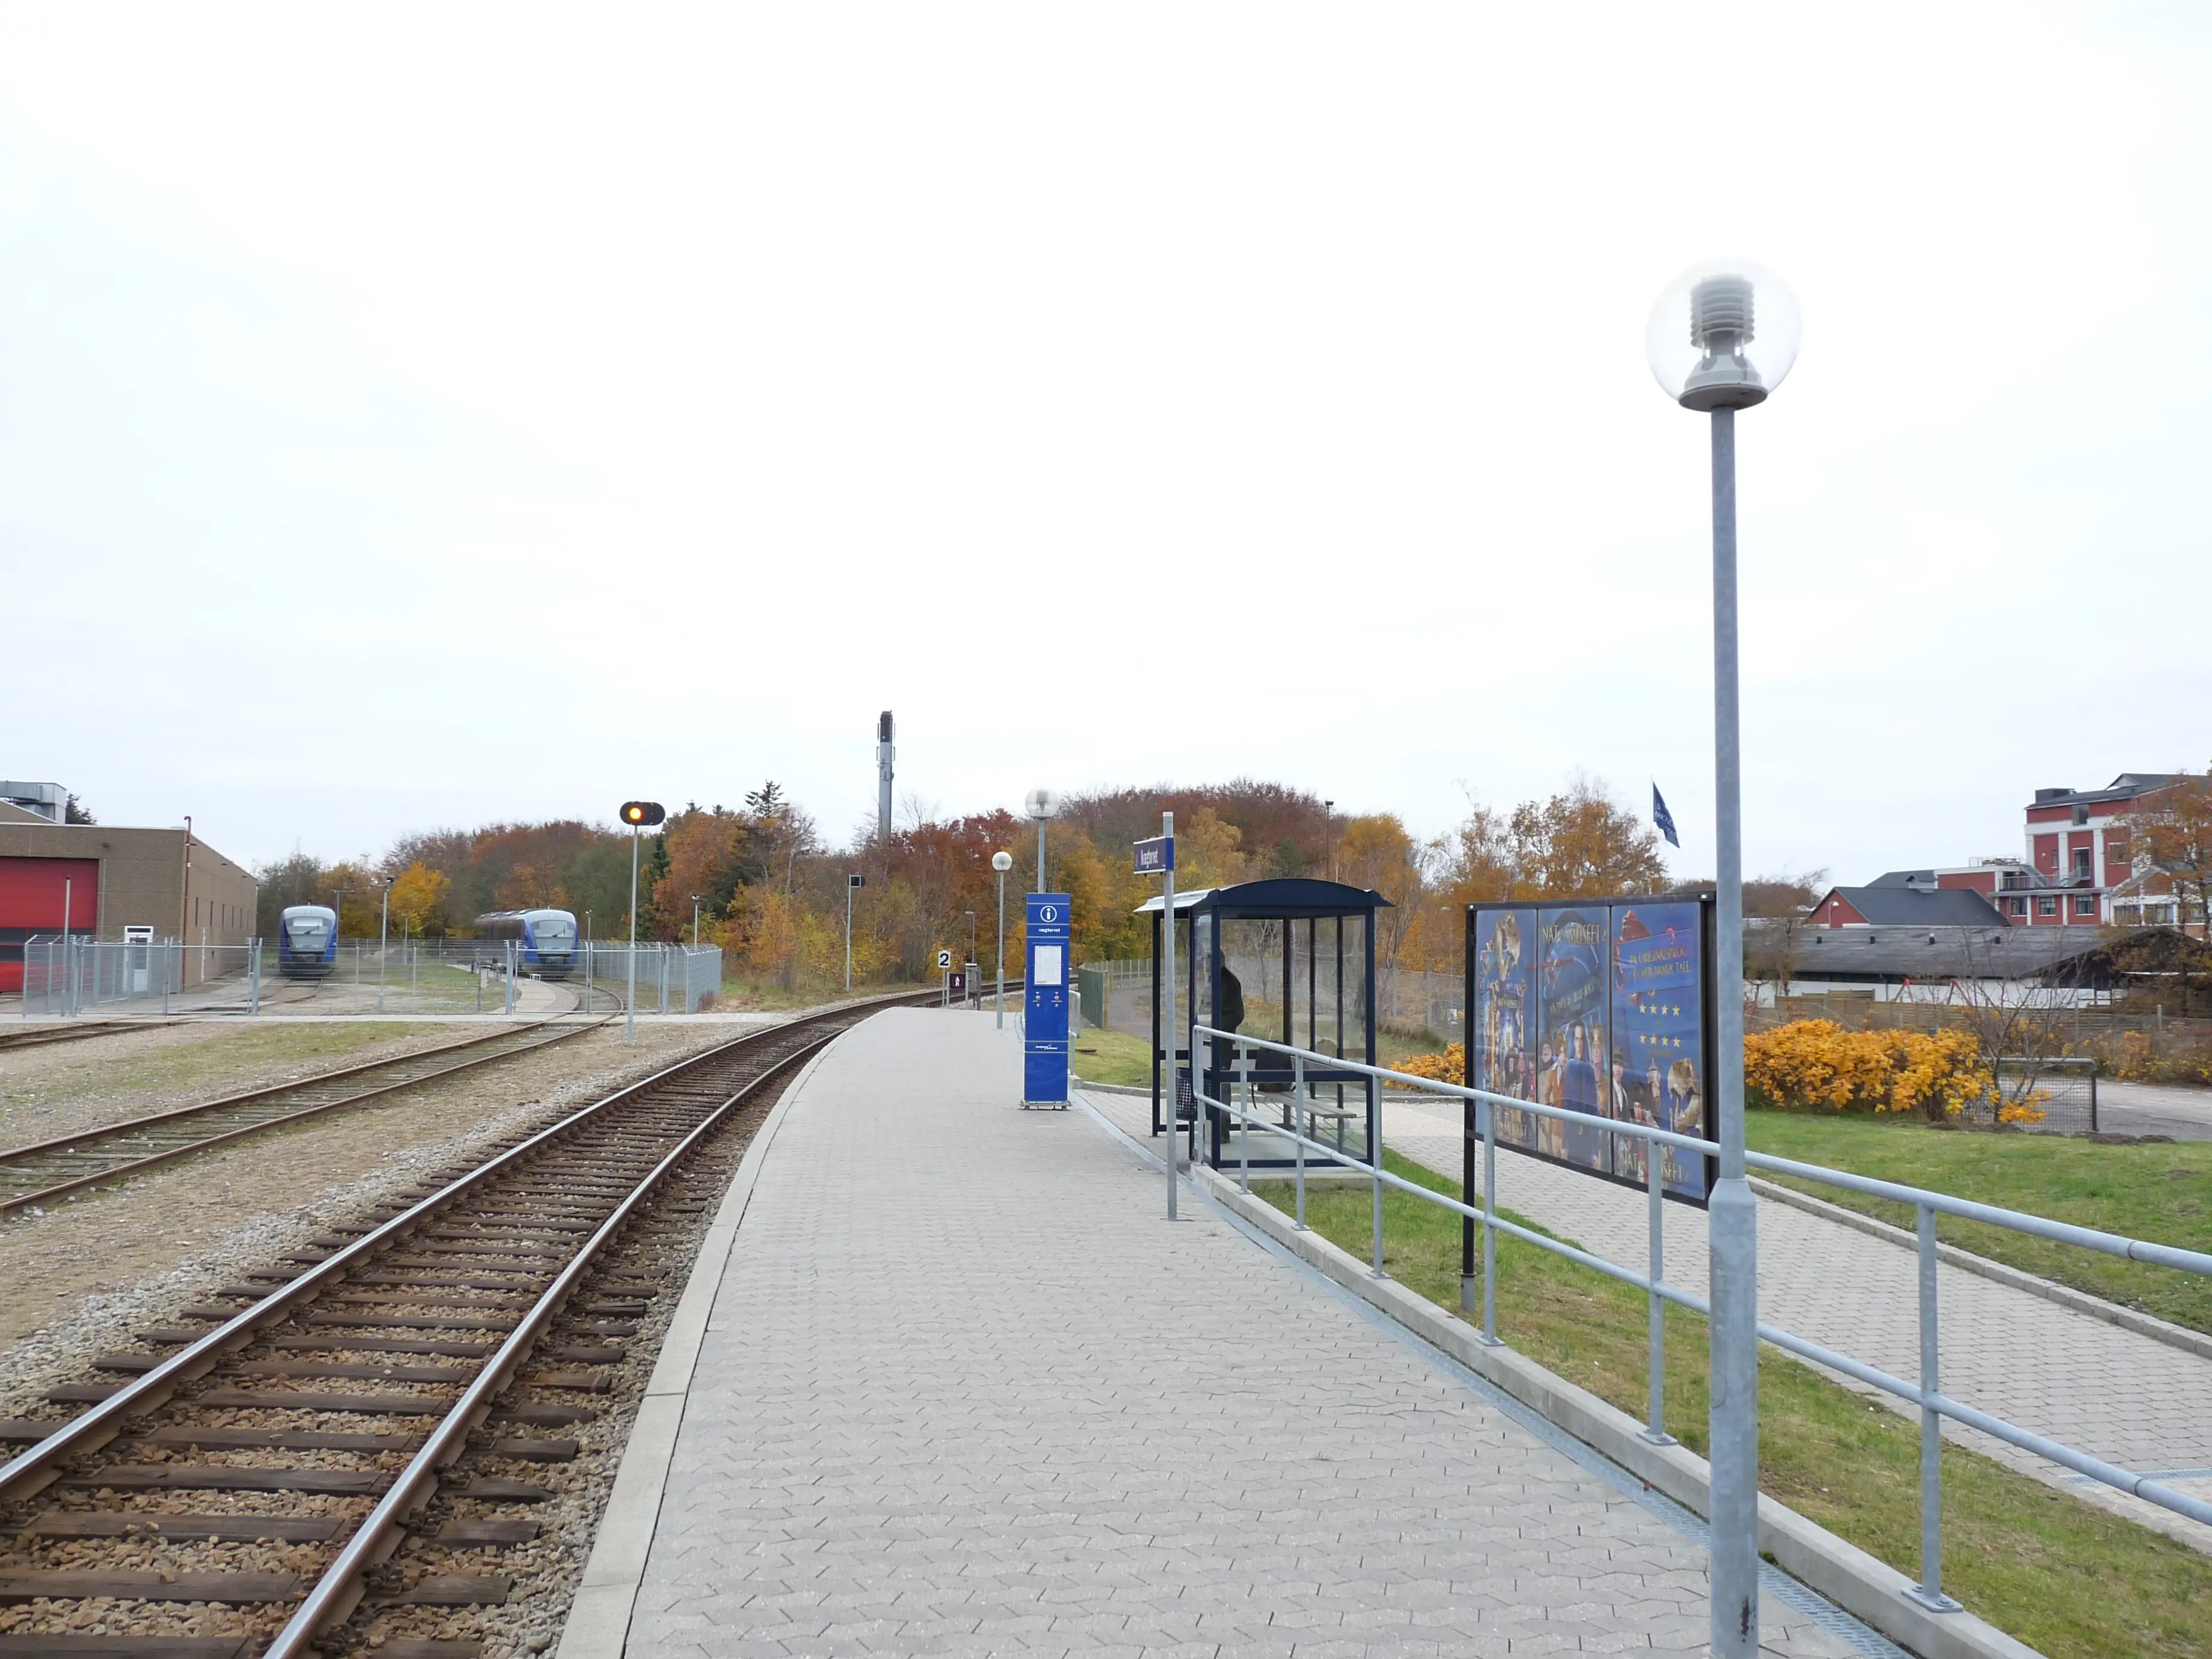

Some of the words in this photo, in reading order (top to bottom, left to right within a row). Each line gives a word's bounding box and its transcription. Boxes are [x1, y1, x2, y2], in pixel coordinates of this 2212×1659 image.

[1542, 925, 1558, 943] NAT
[1568, 924, 1600, 944] MUSEET
[939, 953, 949, 966] 2
[1676, 960, 1690, 973] TALE
